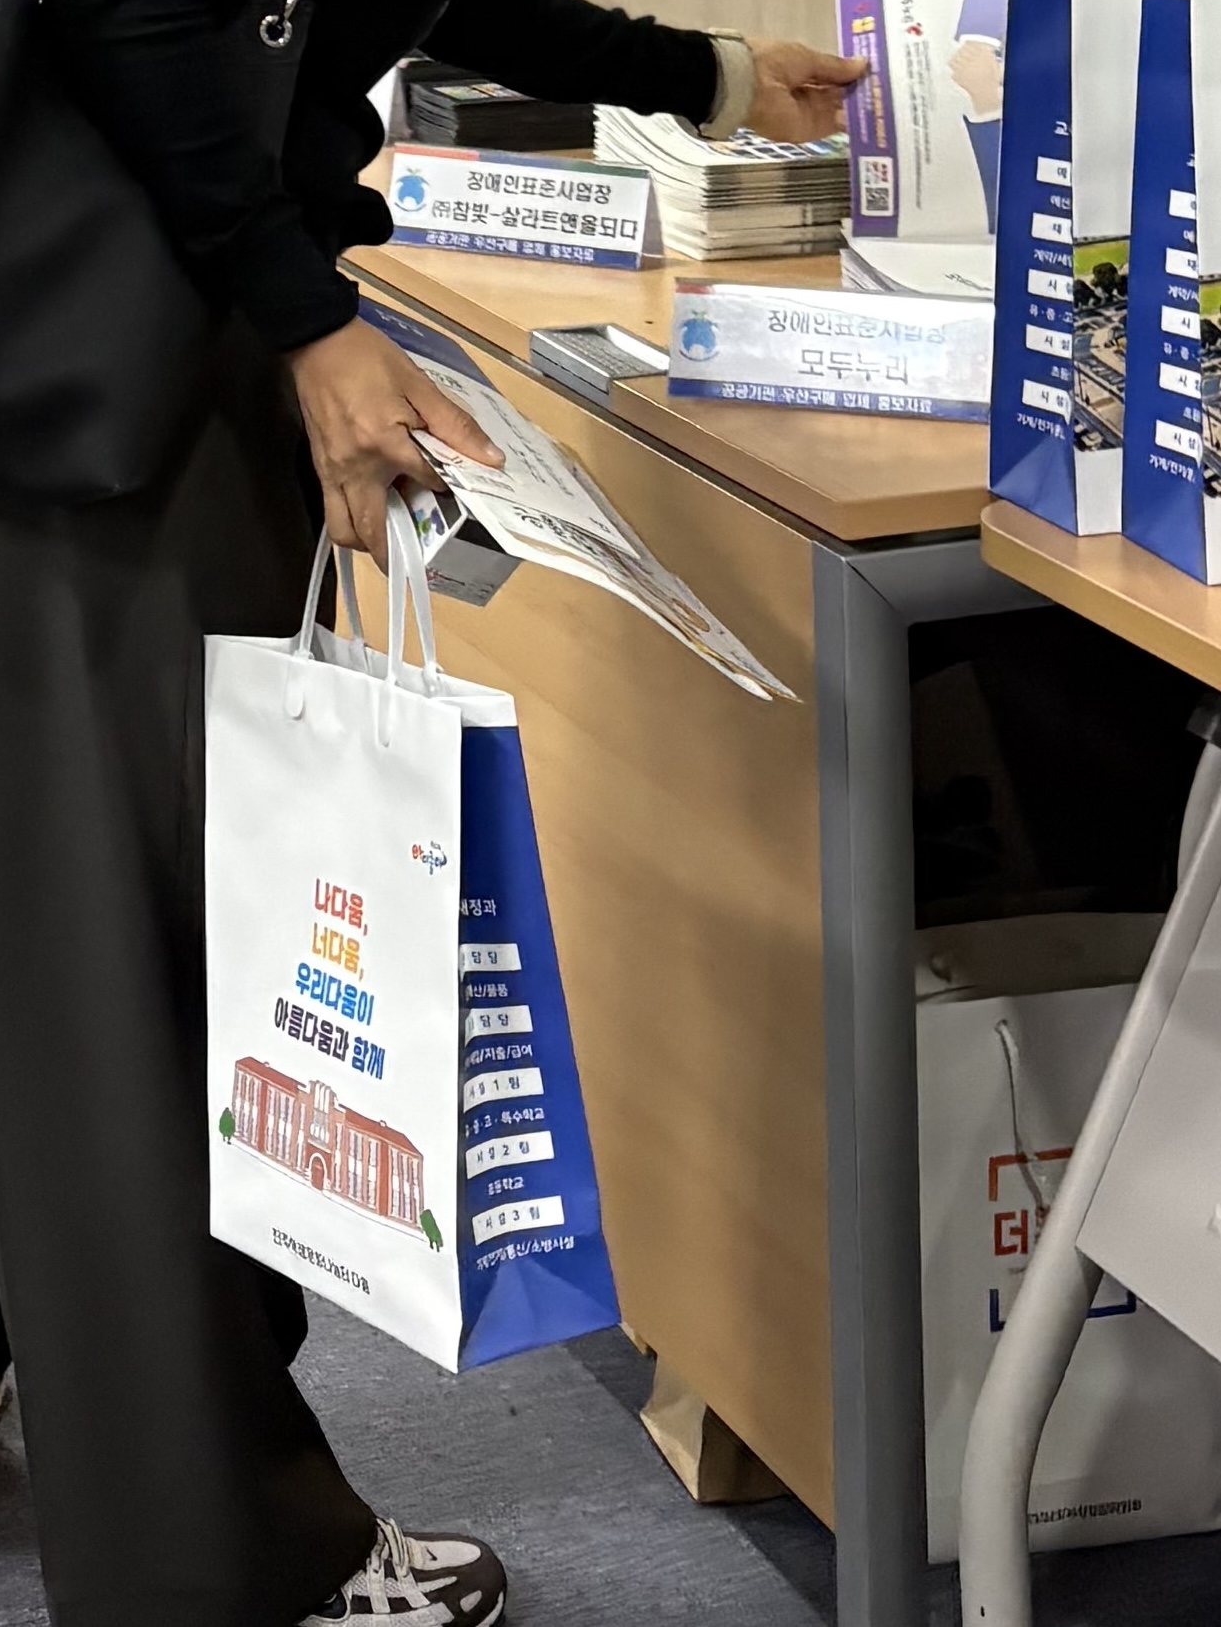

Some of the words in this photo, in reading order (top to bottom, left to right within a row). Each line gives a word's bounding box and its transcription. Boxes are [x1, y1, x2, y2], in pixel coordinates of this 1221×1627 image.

[467, 170, 611, 205] 장애인표준사업장
[768, 309, 946, 345] 장애인표준사업장
[798, 349, 908, 385] 모두누리
[315, 878, 368, 936] 나다움,
[312, 922, 364, 982] 너다움,
[295, 962, 375, 1026] 우리다움이
[274, 997, 350, 1062] 아름다움과
[351, 1036, 386, 1080] 함께
